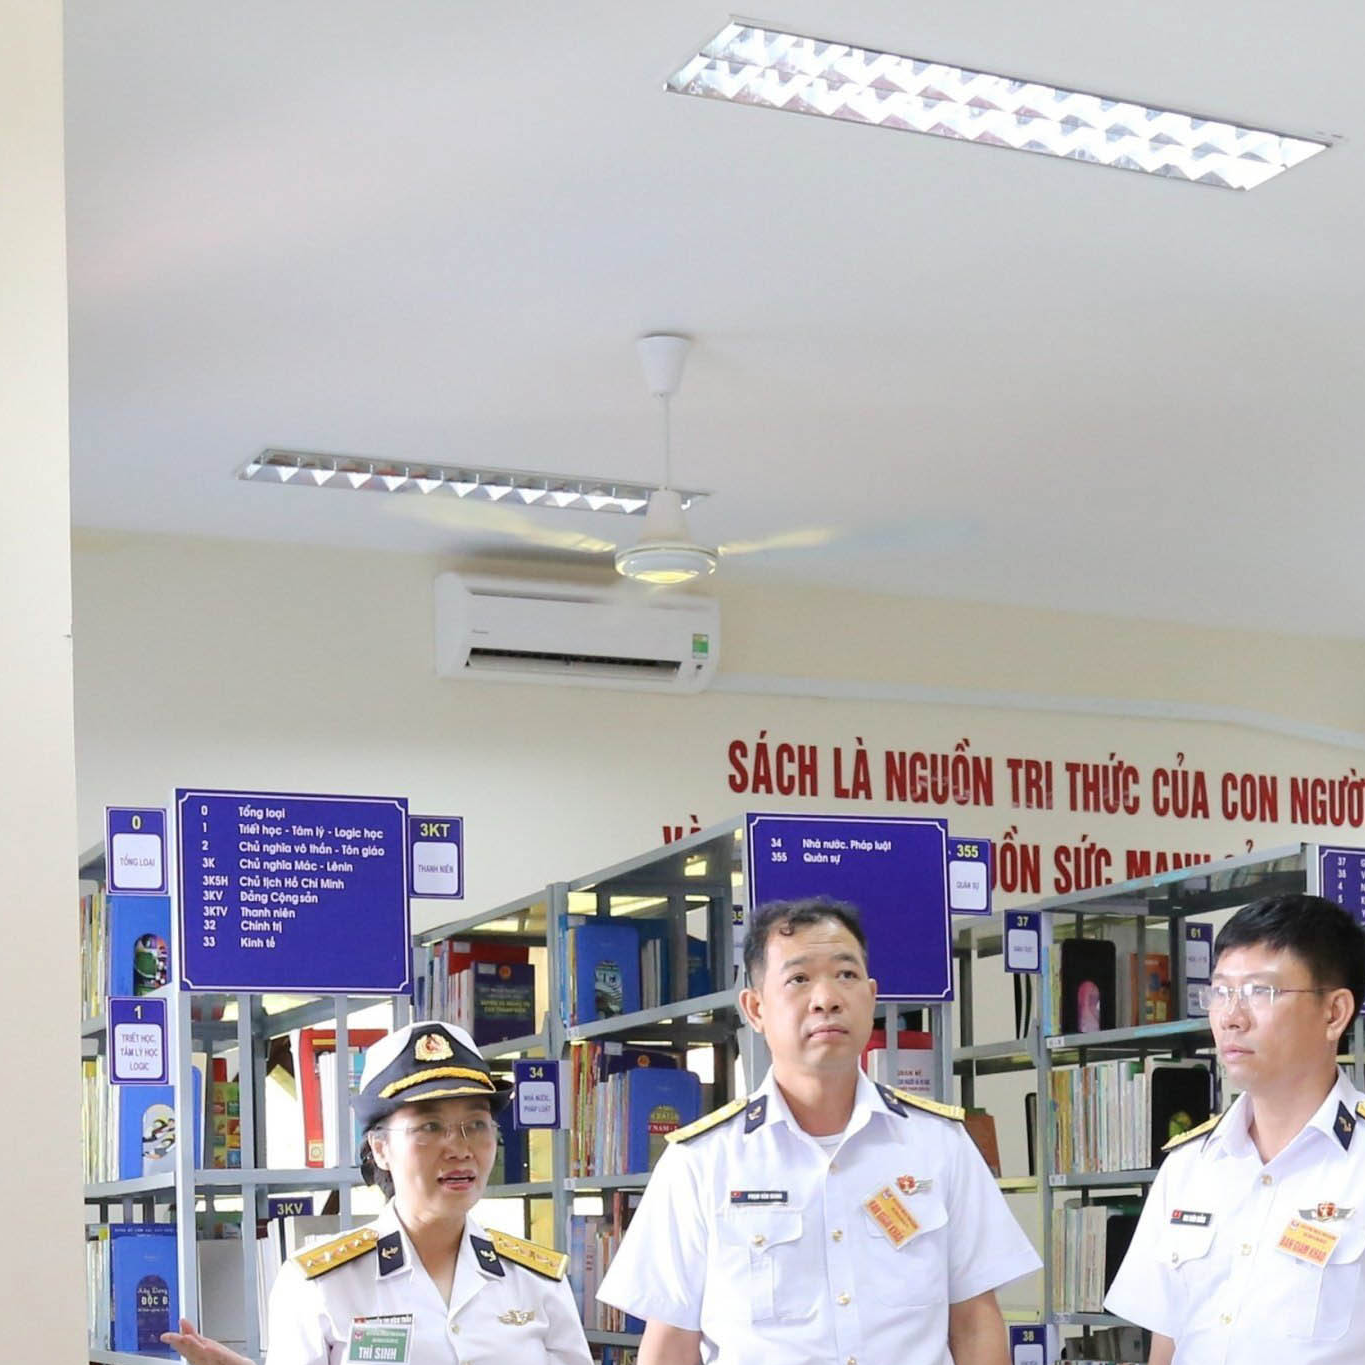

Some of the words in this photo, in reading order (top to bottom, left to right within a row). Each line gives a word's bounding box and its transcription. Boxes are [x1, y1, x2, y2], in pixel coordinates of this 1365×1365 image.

[728, 730, 817, 797] SÁCH
[834, 737, 872, 800] LÀ
[886, 738, 994, 806] NGUỒN
[1007, 758, 1053, 811] TRI
[1066, 752, 1140, 815] THỨC
[1153, 752, 1210, 819] CỦA
[1222, 772, 1278, 823] CON
[239, 804, 263, 819] Tổng
[266, 808, 285, 820] loại
[132, 815, 141, 830] 0
[239, 822, 259, 835] Triết
[262, 824, 282, 837] học
[292, 825, 314, 836] Tâm
[335, 828, 361, 839] Logic
[364, 827, 383, 841] học
[420, 823, 450, 837] 3KT
[202, 841, 208, 850] 2
[239, 840, 260, 852] Chủ
[263, 841, 291, 855] nghĩa
[294, 842, 307, 853] vô
[309, 841, 332, 854] thần
[342, 843, 359, 855] Tôn
[362, 845, 384, 857] giáo
[771, 838, 782, 848] 34
[957, 845, 979, 858] 355
[203, 858, 215, 868] 3K
[239, 856, 260, 869] Chủ
[263, 858, 292, 872] nghĩa
[295, 860, 317, 871] Mác
[327, 859, 353, 872] Lênin
[239, 875, 260, 887] Chủ
[285, 877, 298, 888] Hồ
[321, 878, 344, 889] Minh
[203, 891, 223, 901] 3KV
[203, 906, 227, 917] 3KTV
[241, 907, 271, 918] Thanh
[273, 907, 295, 918] niên
[203, 920, 216, 930] 32
[241, 920, 270, 932] Chính
[1017, 916, 1029, 927] 37
[203, 937, 215, 947] 33
[241, 938, 263, 948] Kinh
[134, 1005, 141, 1020] 1
[130, 1062, 149, 1071] LOGIC
[529, 1067, 543, 1079] 34
[277, 1203, 303, 1215] 3KV
[374, 1347, 397, 1360] SINH
